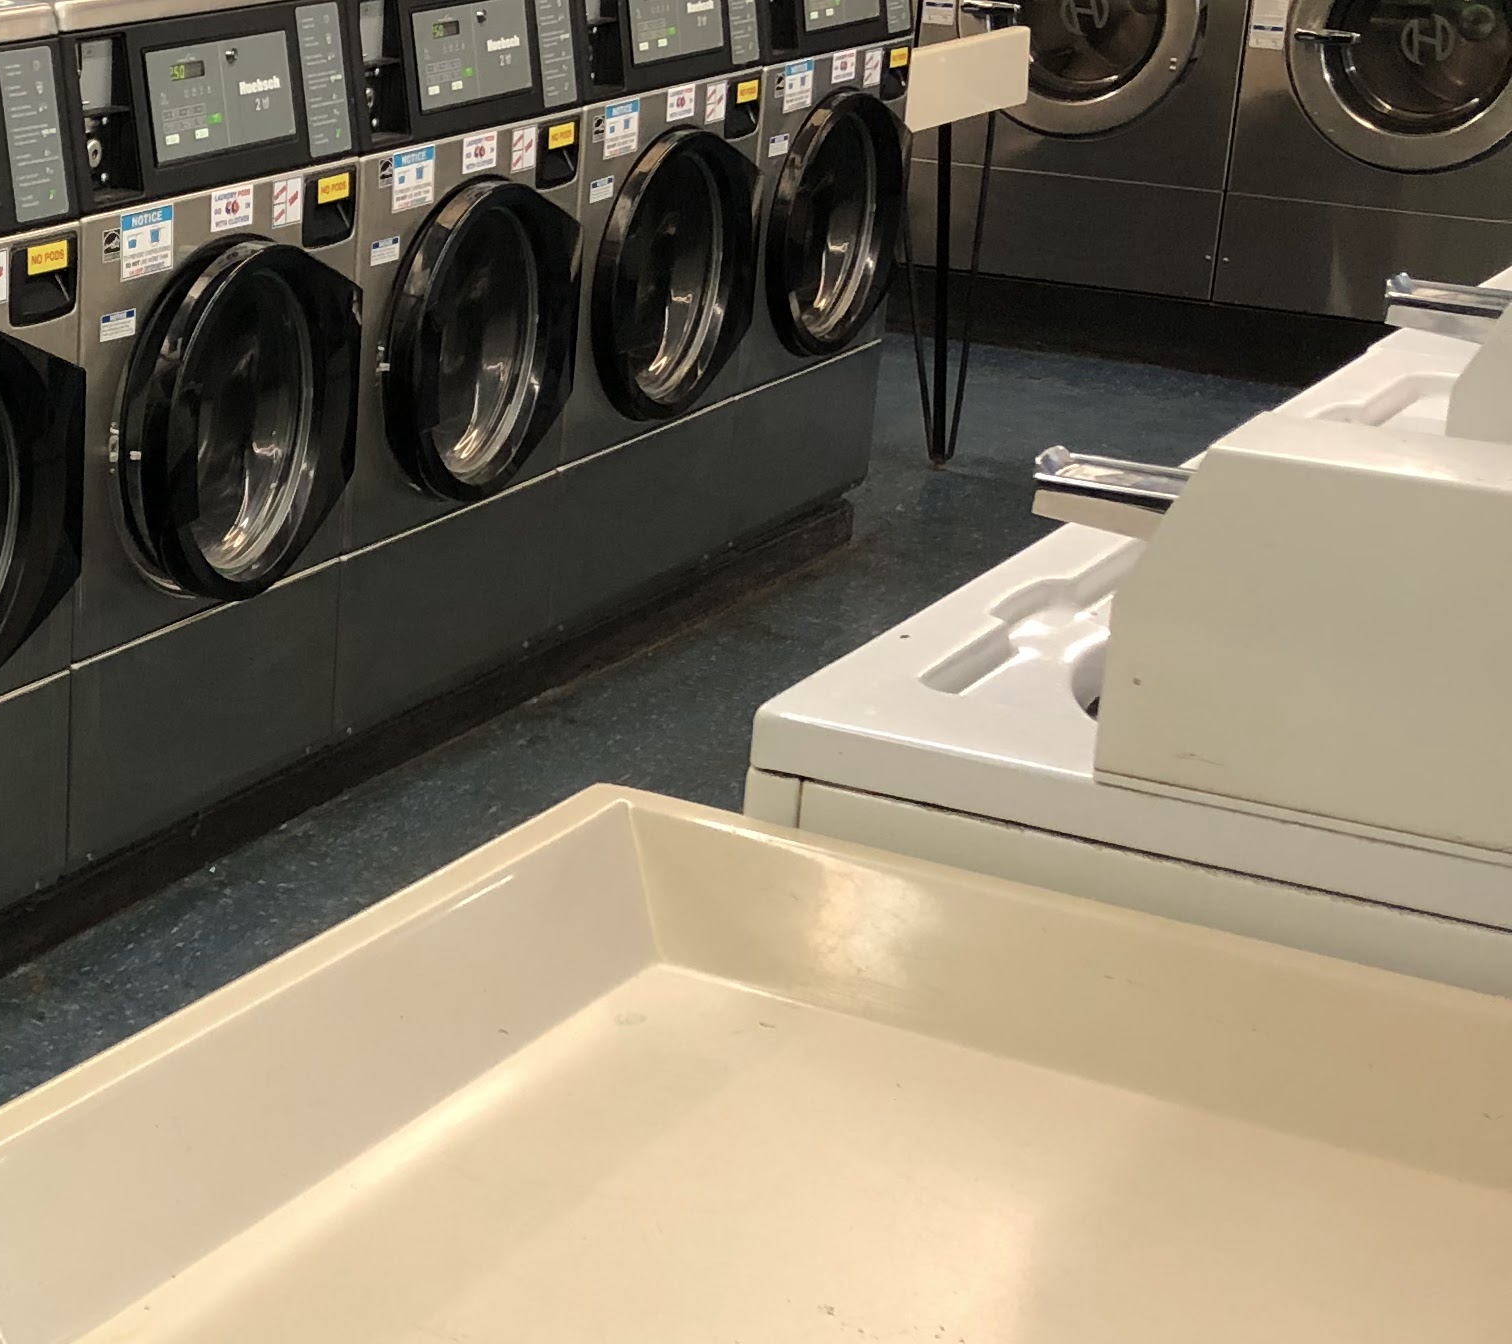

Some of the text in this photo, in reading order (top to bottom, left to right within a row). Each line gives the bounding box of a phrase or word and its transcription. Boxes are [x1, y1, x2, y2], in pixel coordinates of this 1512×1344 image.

[255, 97, 262, 111] 2
[131, 210, 163, 227] NOTICE
[31, 249, 65, 265] NO PODS
